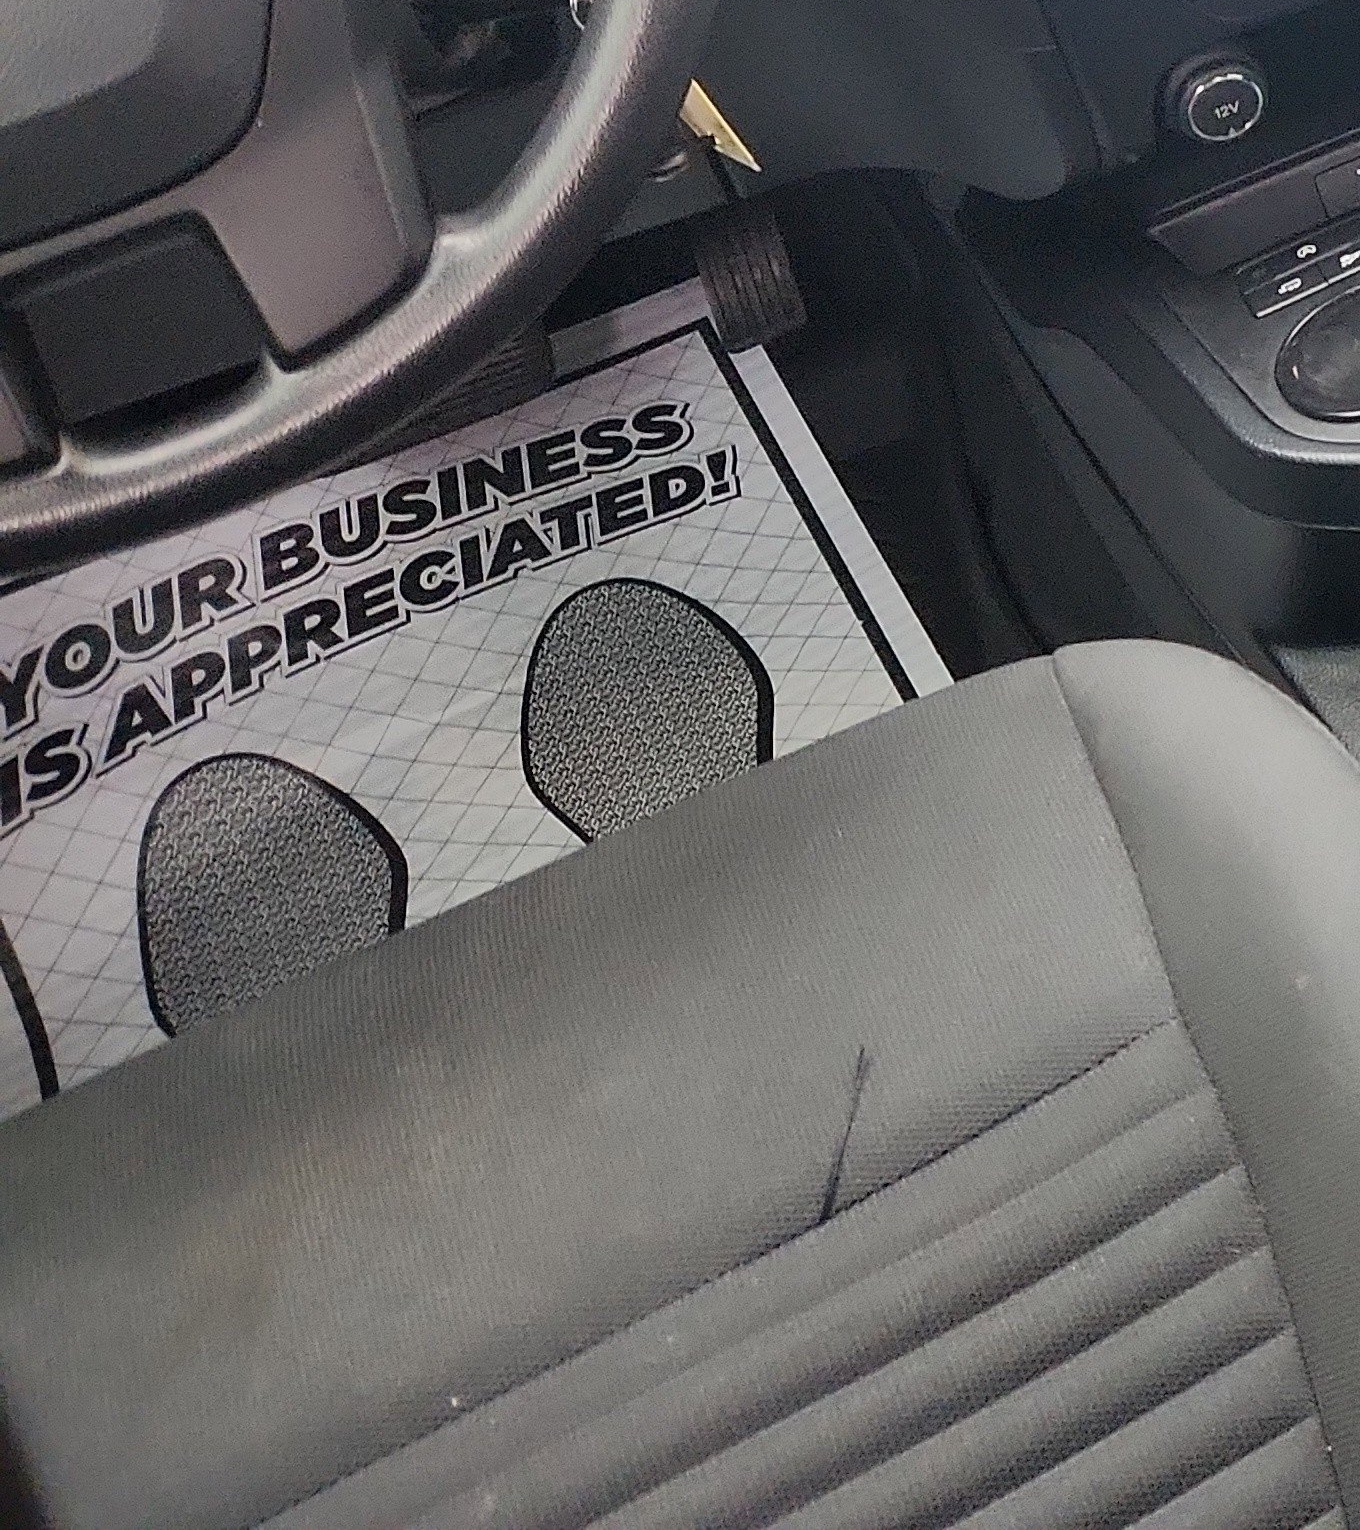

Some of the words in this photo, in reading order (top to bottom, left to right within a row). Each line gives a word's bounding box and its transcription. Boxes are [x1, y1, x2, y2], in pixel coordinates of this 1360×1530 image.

[1214, 100, 1239, 119] 12V
[0, 559, 252, 738] YOUR
[259, 400, 693, 601] BUSINESS
[0, 723, 93, 841] IS
[96, 446, 742, 779] APPRECIATED!
